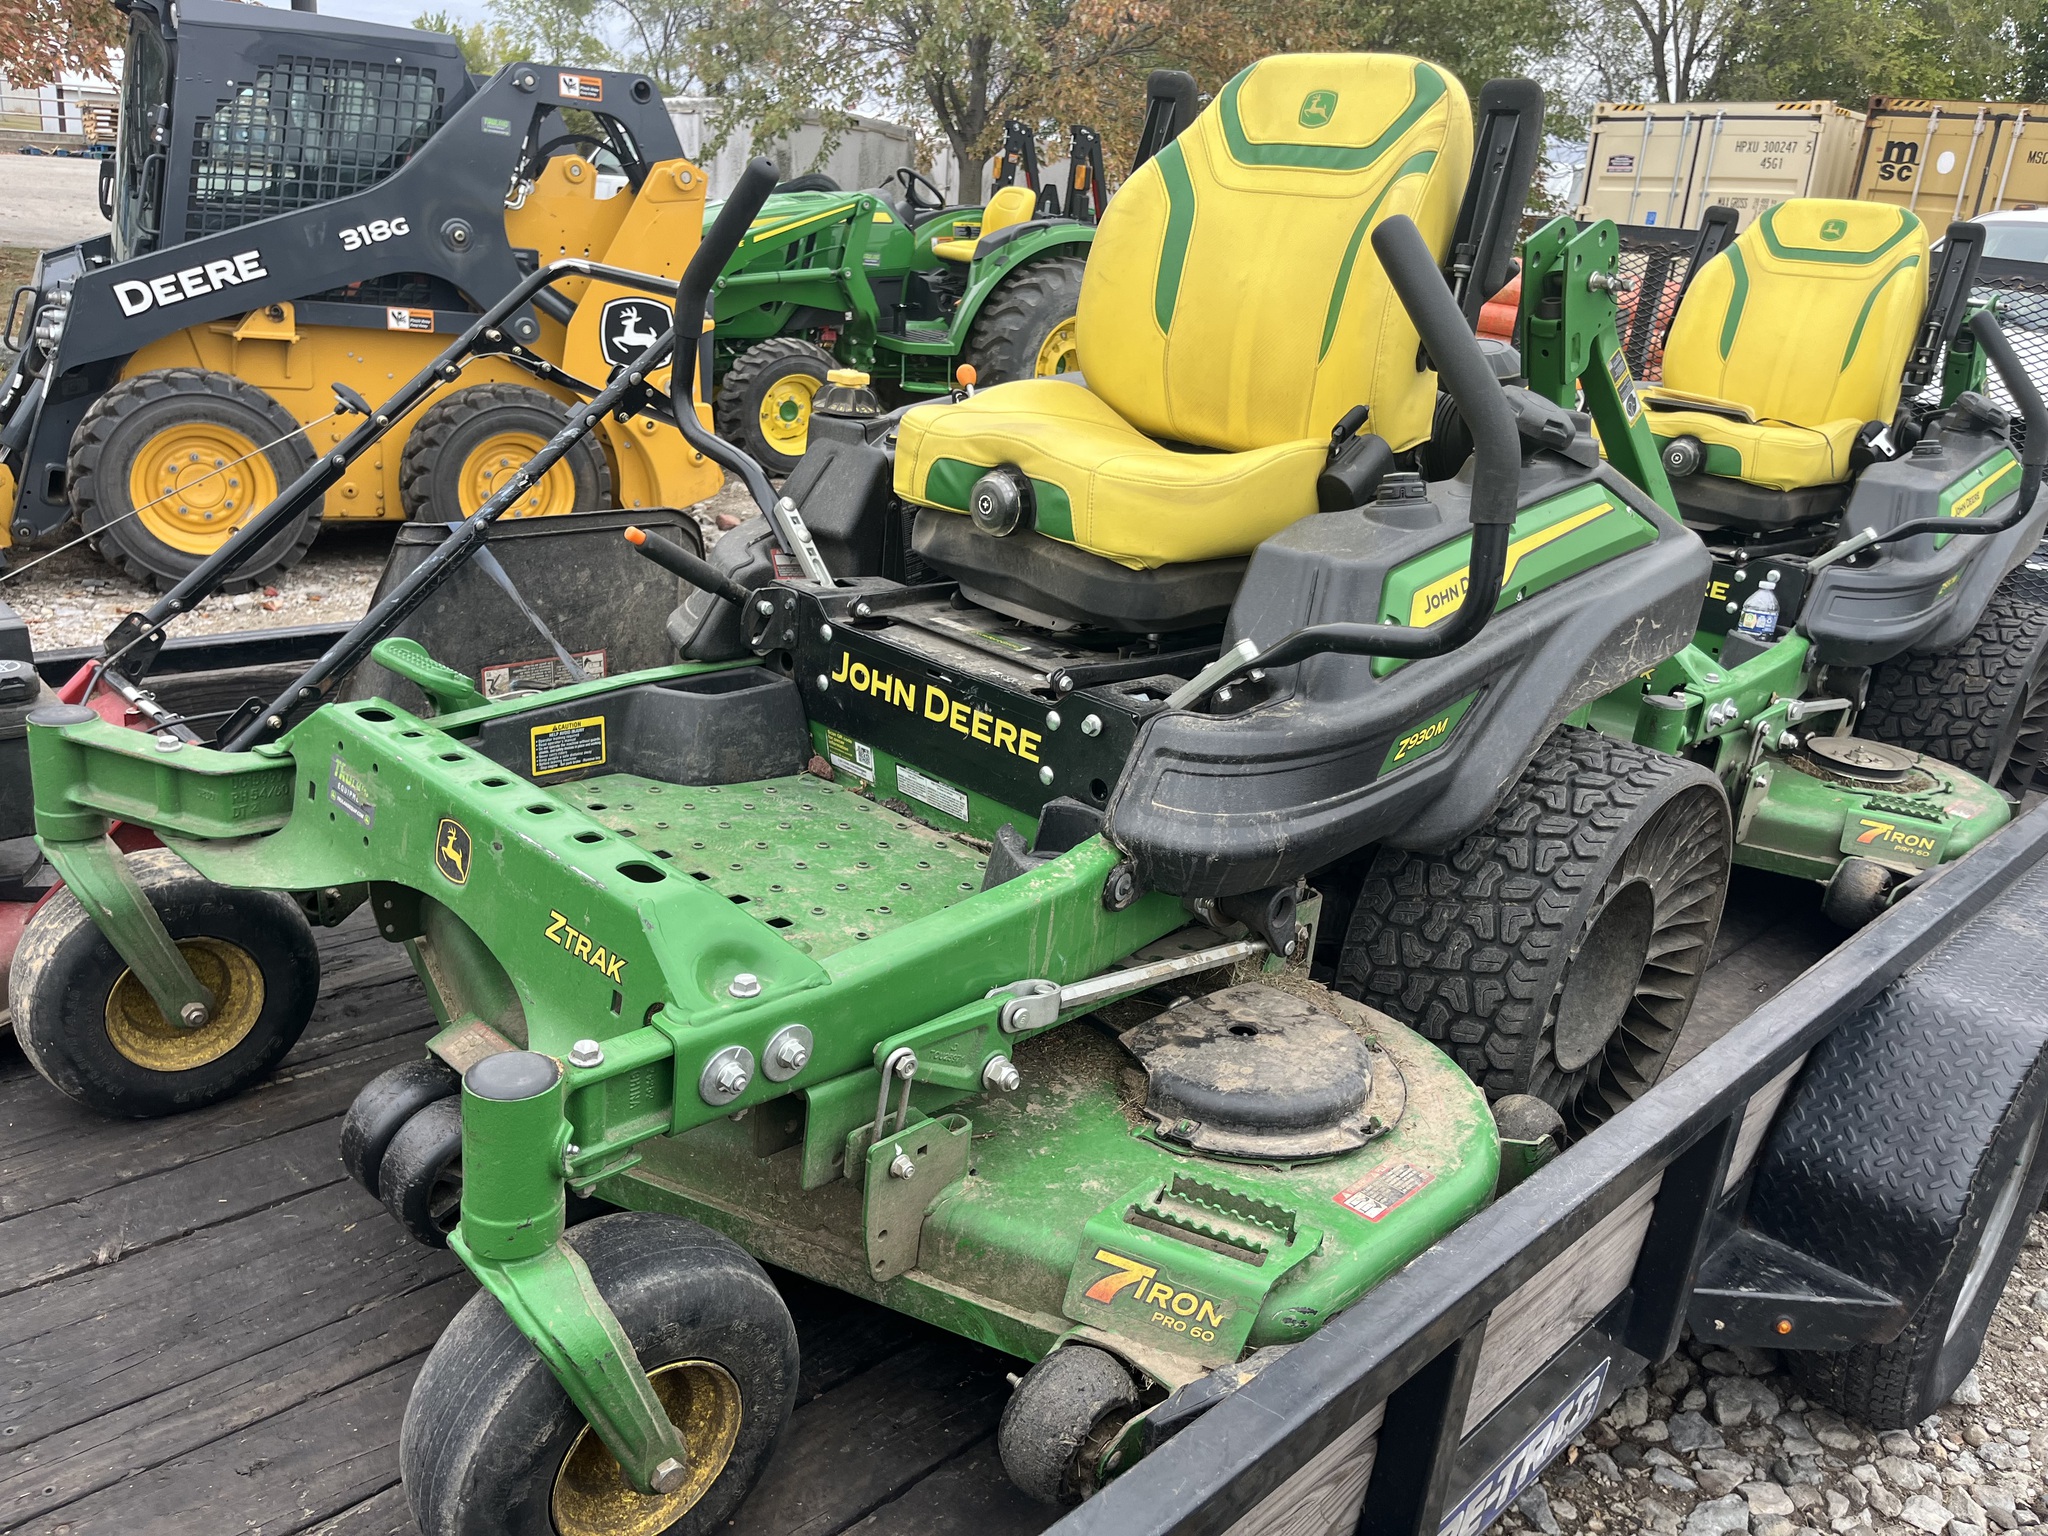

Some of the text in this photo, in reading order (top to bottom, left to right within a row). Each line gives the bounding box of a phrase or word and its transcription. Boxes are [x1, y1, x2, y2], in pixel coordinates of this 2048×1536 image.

[1736, 141, 1812, 154] HPXU 300247 5
[1760, 157, 1783, 169] 45G1
[338, 217, 410, 251] 318G
[112, 250, 267, 317] DEERE
[1424, 582, 1459, 614] JOHN
[831, 651, 1042, 764] JOHN DEERE
[558, 722, 581, 731] CAUTION
[1393, 716, 1449, 762] Z930M
[544, 909, 629, 986] ZTRAK
[1150, 1311, 1216, 1343] PRO 60
